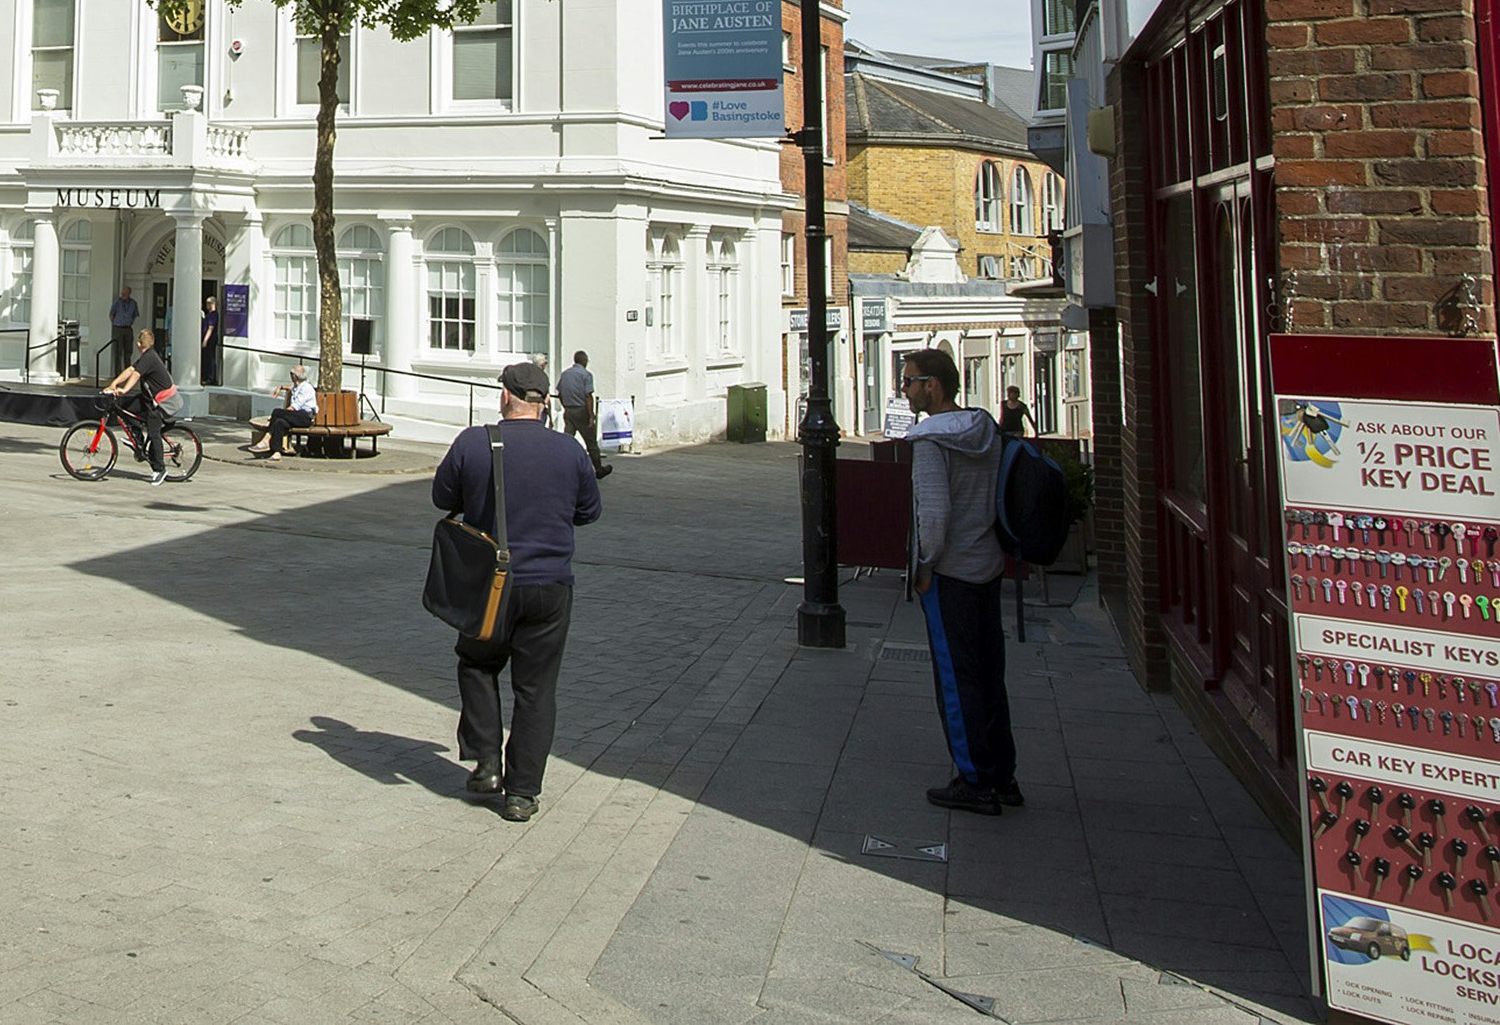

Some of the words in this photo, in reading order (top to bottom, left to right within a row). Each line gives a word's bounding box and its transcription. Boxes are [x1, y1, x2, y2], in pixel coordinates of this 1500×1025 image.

[672, 2, 750, 16] BIRTHPLACE
[755, 1, 774, 12] OF
[672, 17, 709, 34] JANE
[713, 14, 774, 29] AUSTEN
[681, 81, 766, 89] www.celebratingjane.co.uk
[712, 101, 748, 110] #Love
[712, 111, 781, 123] Basingstoke
[56, 188, 161, 209] MUSEUM
[155, 244, 171, 265] THE
[203, 234, 225, 261] MUSE
[1356, 422, 1387, 435] ASK
[1391, 424, 1446, 437] ABOUT
[1451, 427, 1487, 440] OUR
[1394, 443, 1493, 471] PRICE
[1361, 467, 1411, 489] KEY
[1420, 472, 1495, 496] DEAL
[1322, 629, 1435, 658] SPECIALIST
[1444, 645, 1499, 666] KEYS
[1331, 748, 1372, 767] CAR
[1378, 755, 1416, 774] KEY
[1422, 956, 1500, 989] LOCKS
[1342, 989, 1361, 999] LOCK
[1362, 993, 1382, 1004] OUTS
[1362, 984, 1393, 998] OPENING
[1405, 996, 1425, 1006] LOCK
[1426, 1001, 1454, 1014] FITTING
[1406, 1006, 1426, 1016] LOCK
[1427, 1010, 1457, 1024] REPAIRS
